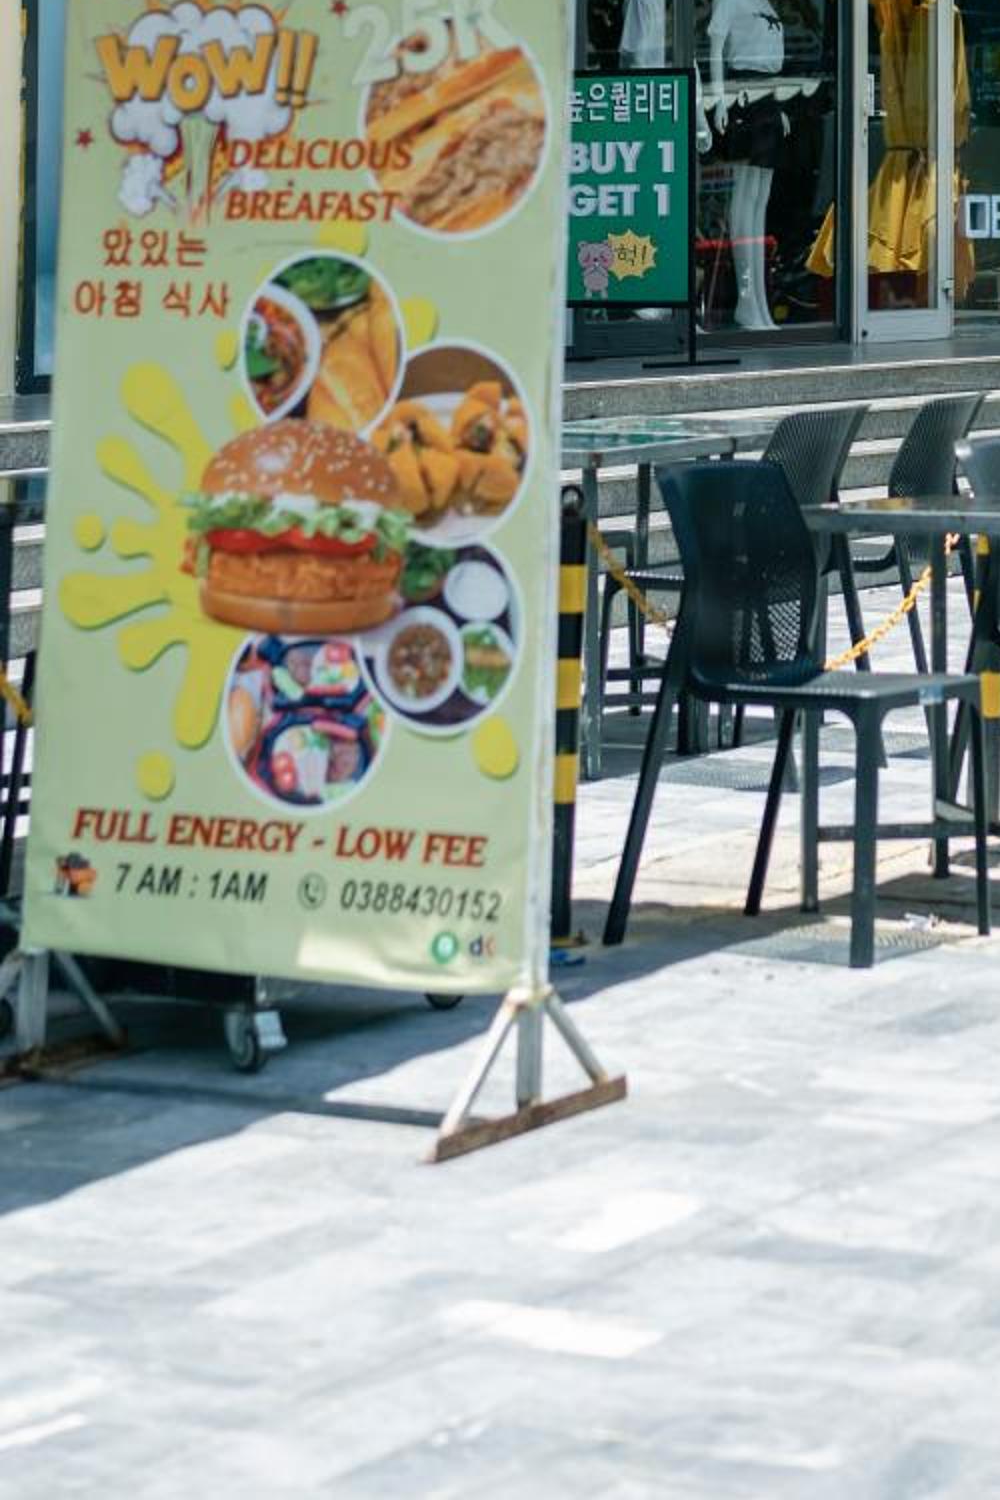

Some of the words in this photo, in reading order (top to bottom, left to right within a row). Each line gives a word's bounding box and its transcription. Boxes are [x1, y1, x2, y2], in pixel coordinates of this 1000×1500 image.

[228, 138, 412, 171] DELICIOUS
[568, 140, 644, 174] BUY
[657, 140, 675, 173] 1
[568, 183, 640, 217] GET
[653, 183, 671, 217] 1
[75, 280, 142, 318] 아침
[162, 280, 229, 319] 식사
[72, 806, 157, 843] FULL
[166, 813, 304, 853] ENERGY
[335, 825, 416, 861] LOW
[422, 832, 489, 868] FEE
[115, 862, 132, 893] 7
[135, 864, 184, 896] AM
[339, 879, 503, 922] 0388430152
